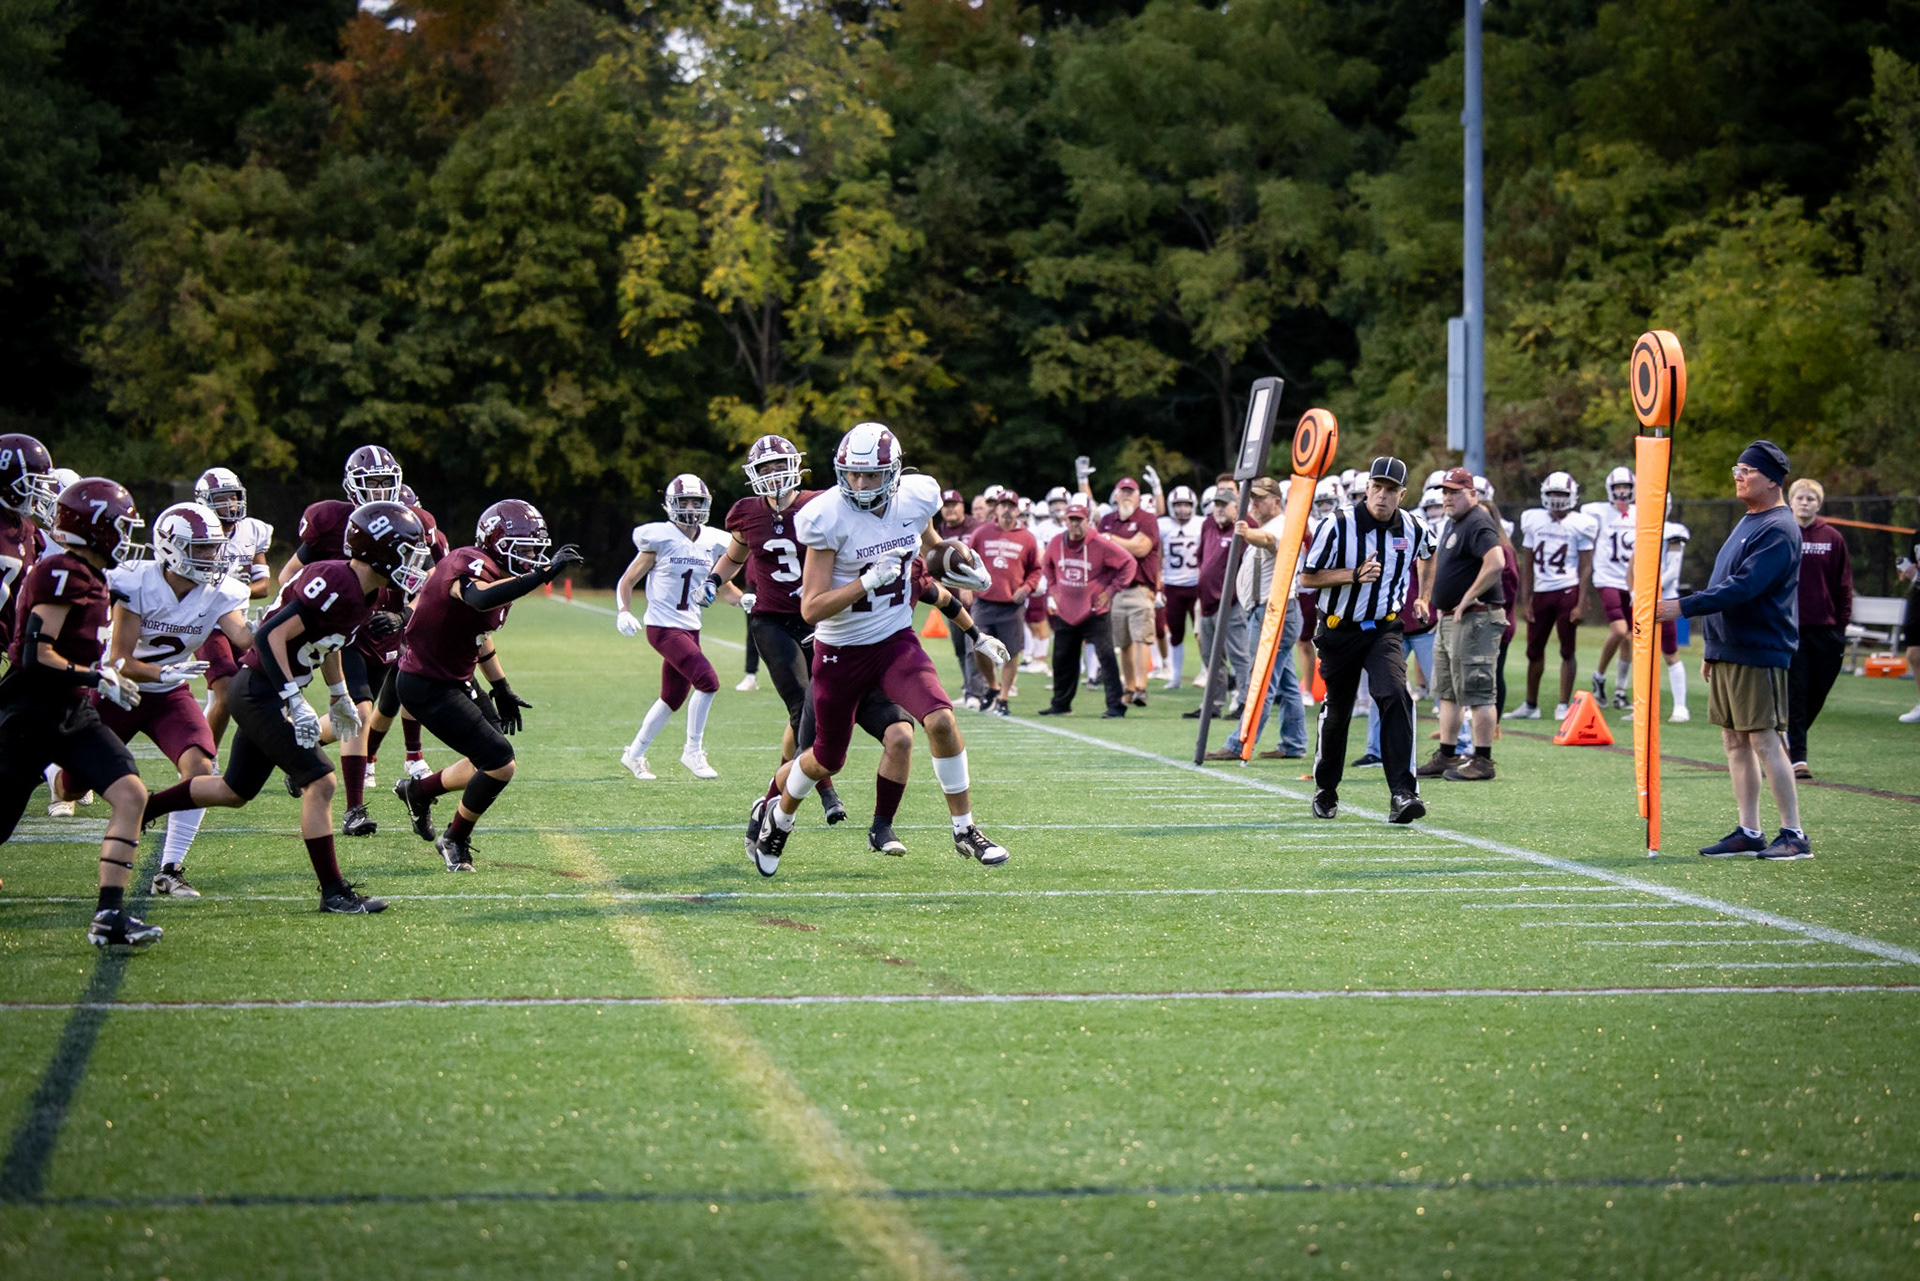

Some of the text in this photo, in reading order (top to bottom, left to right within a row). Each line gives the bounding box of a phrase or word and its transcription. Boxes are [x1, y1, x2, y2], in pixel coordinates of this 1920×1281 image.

[89, 500, 108, 525] 7
[368, 515, 393, 541] 81
[763, 538, 802, 582] 3
[856, 534, 916, 559] NORTHBRIDGE
[1169, 541, 1198, 569] 53
[1534, 540, 1569, 574] 44
[468, 558, 485, 577] 4
[51, 569, 69, 597] 7
[303, 576, 339, 612] 81
[676, 568, 694, 611] 1
[141, 619, 204, 635] NORTHBRIDGE
[137, 635, 187, 664] 2
